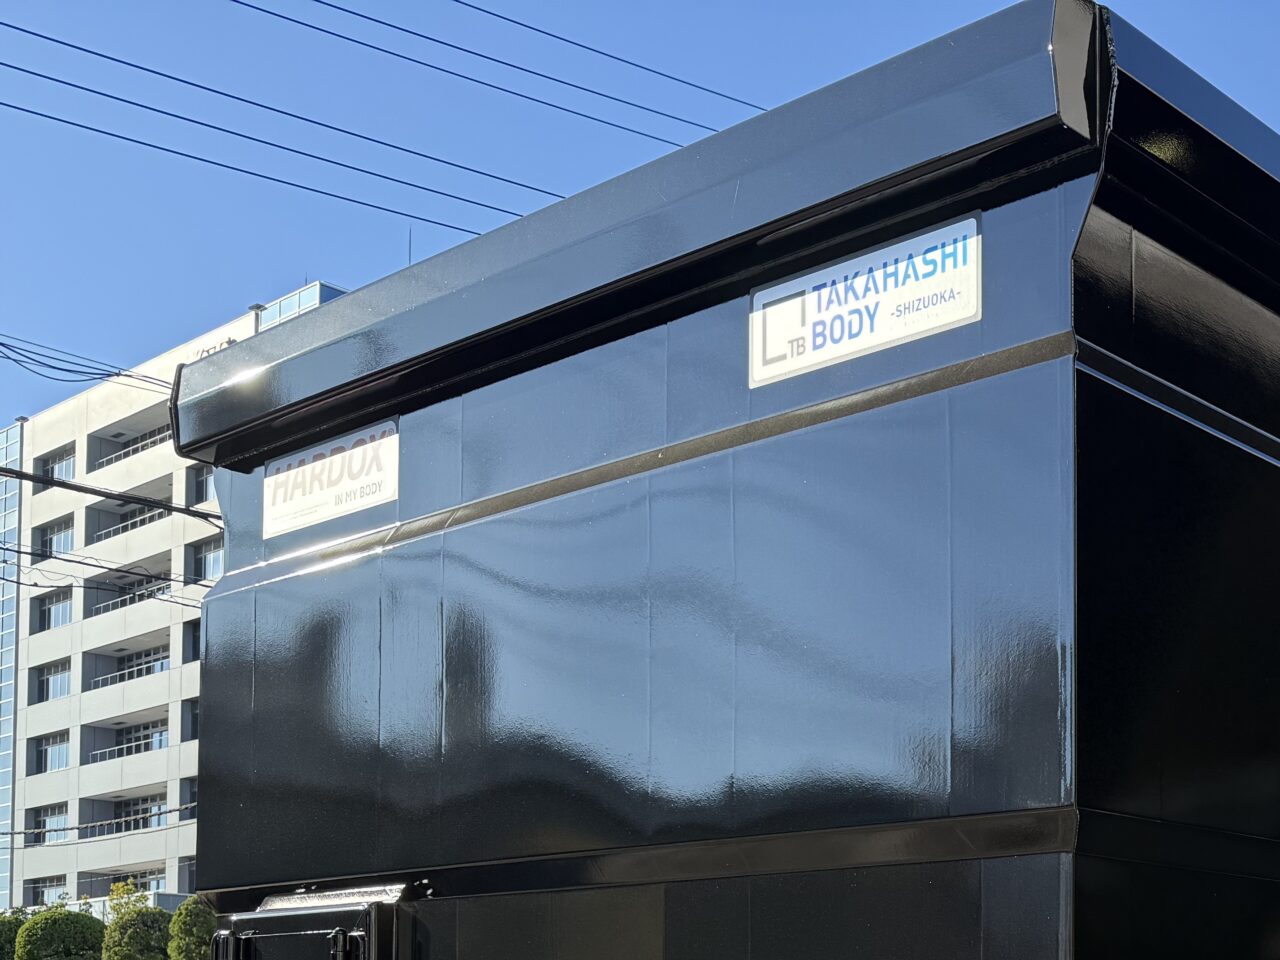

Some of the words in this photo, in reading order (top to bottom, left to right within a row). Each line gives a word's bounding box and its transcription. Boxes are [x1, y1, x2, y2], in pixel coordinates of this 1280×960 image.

[812, 234, 968, 314] TAKAHASHI
[812, 301, 880, 352] BODY
[890, 287, 961, 318] -SHIZUOKA-
[787, 336, 806, 359] TB
[334, 494, 343, 506] IN
[345, 490, 359, 502] MY
[360, 480, 383, 497] BODY
